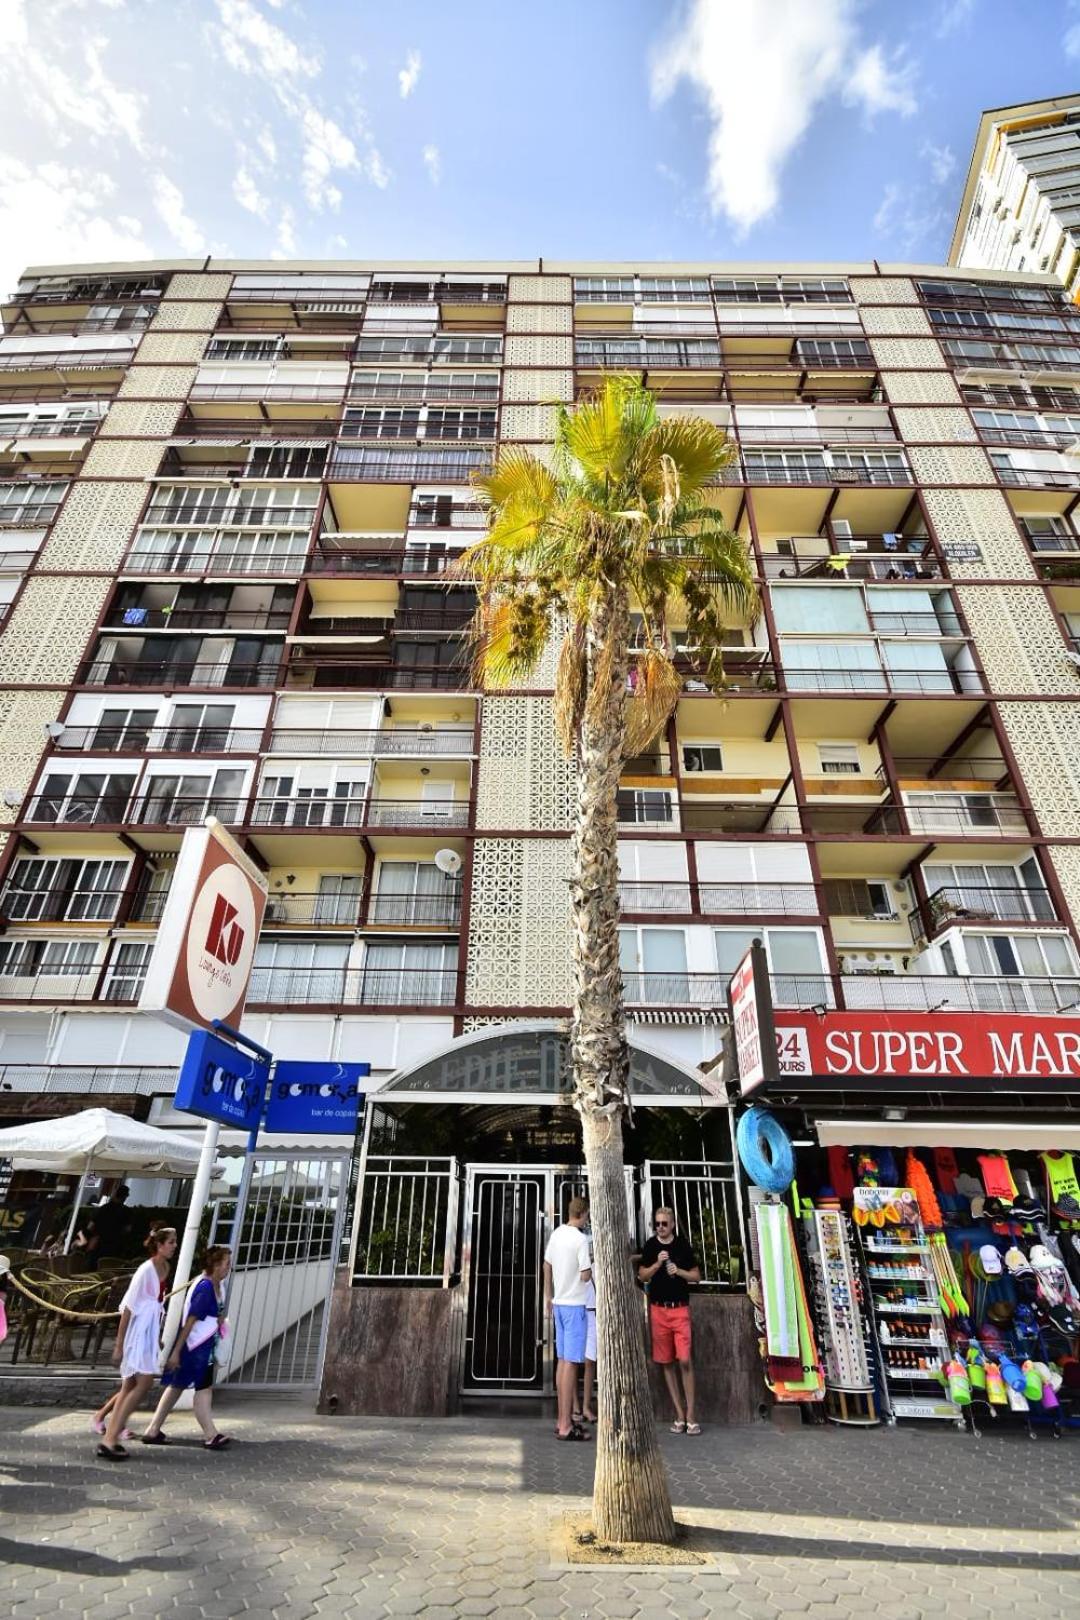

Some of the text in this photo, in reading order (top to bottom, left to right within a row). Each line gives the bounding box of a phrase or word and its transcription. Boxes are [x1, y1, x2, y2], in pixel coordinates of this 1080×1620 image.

[826, 1030, 1080, 1075] SUPER MAR
[779, 1061, 806, 1072] OURS
[423, 1080, 431, 1089] 6
[684, 1084, 691, 1094] 6
[311, 1108, 324, 1116] bar
[324, 1108, 333, 1116] de
